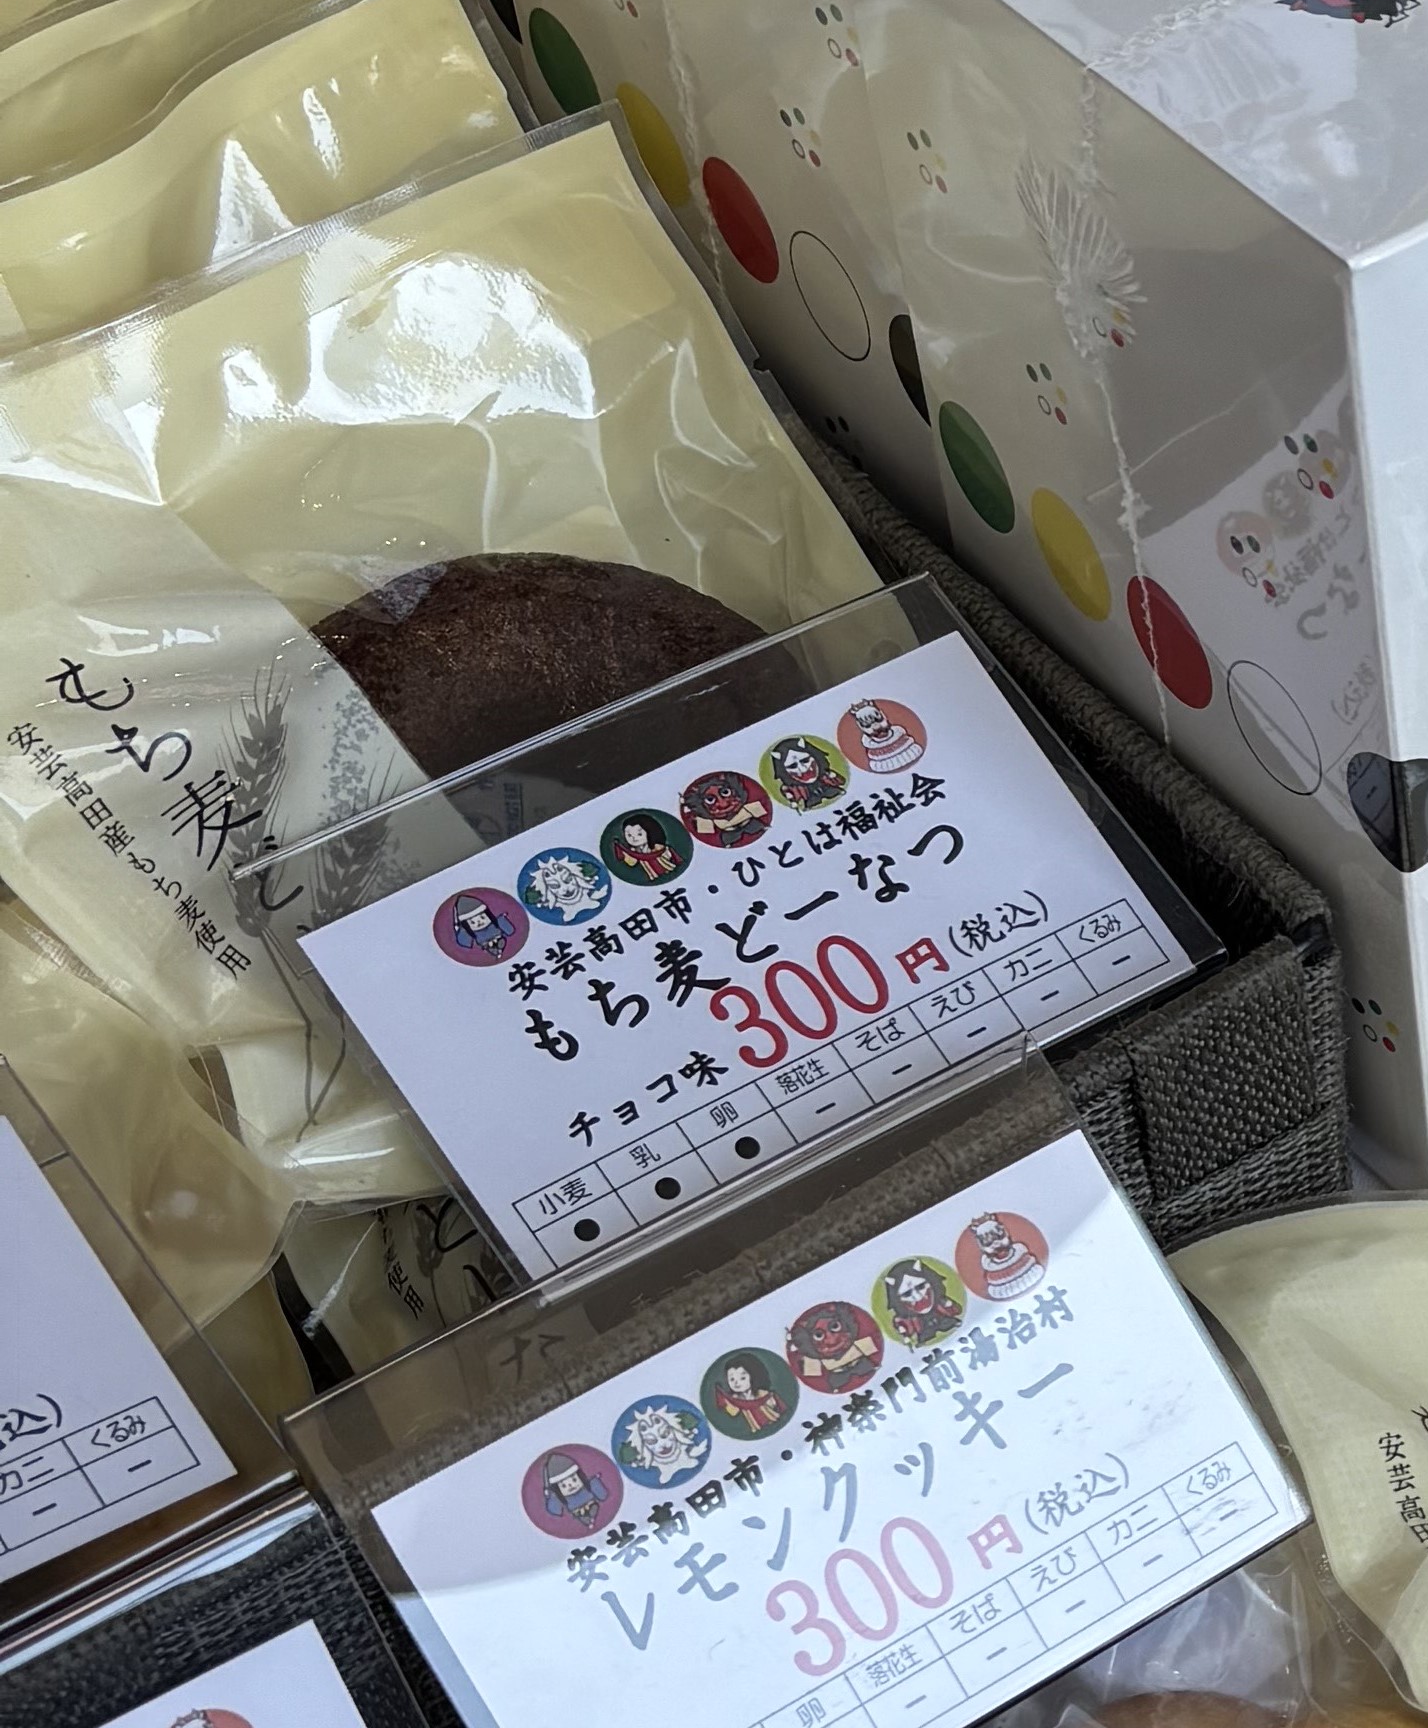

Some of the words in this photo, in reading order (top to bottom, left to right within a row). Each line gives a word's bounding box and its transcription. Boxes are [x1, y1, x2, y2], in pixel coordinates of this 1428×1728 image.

[6, 721, 253, 981] 安芸高田産もち麦使用
[524, 821, 965, 1064] もち麦どーなつ
[537, 1177, 594, 1220] 小麦
[629, 1140, 664, 1173] 乳
[710, 1101, 740, 1131] 卵
[855, 1020, 907, 1055] そば
[930, 983, 976, 1019] えび
[1003, 948, 1053, 985] カニ
[1075, 912, 1126, 950] くるみ
[567, 1051, 730, 1148] チョコ味
[90, 1413, 147, 1449] くるみ
[598, 1361, 1075, 1652] レモンクッキー
[948, 1594, 1002, 1635] そば
[1029, 1547, 1079, 1594] えび
[1106, 1502, 1161, 1543] カニ
